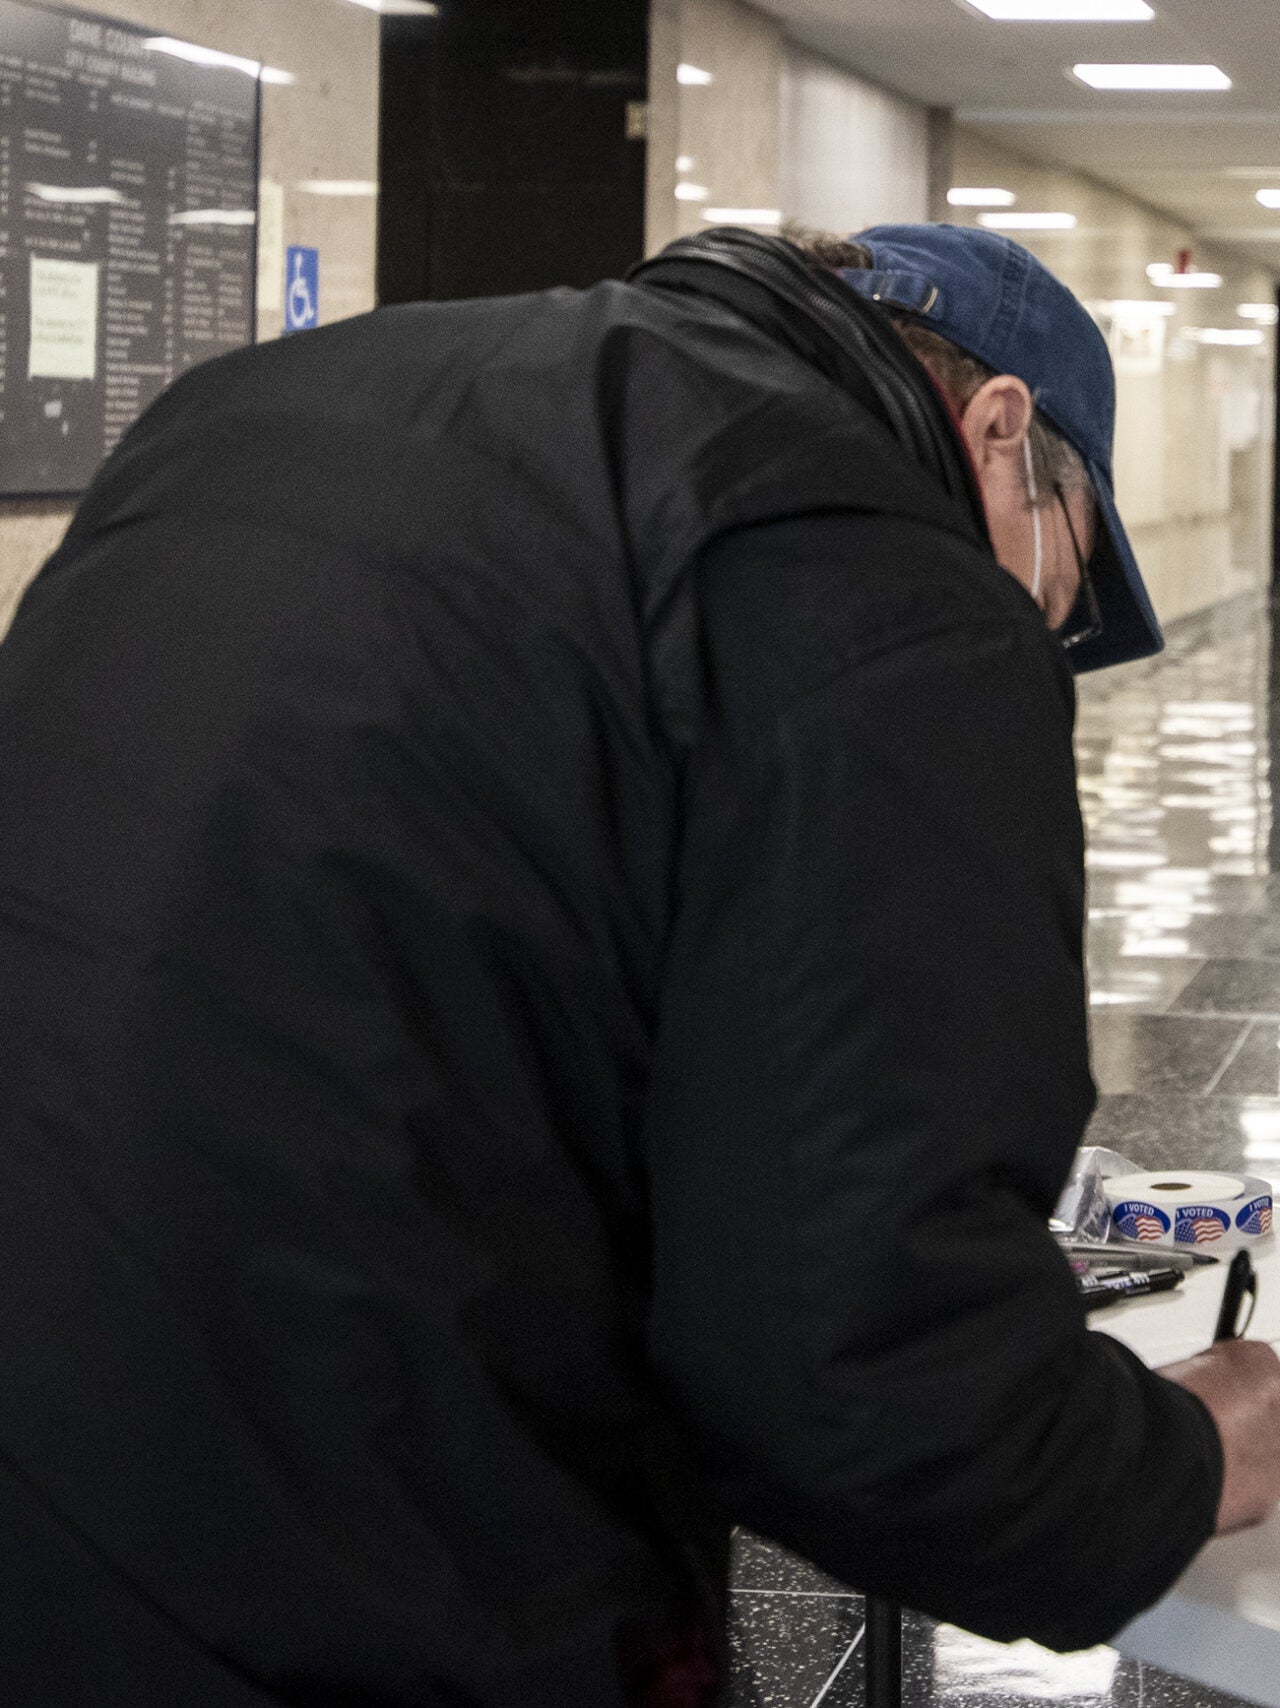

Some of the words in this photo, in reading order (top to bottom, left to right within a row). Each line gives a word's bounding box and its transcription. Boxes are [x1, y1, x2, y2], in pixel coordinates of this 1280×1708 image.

[1124, 1203, 1129, 1212] I
[1128, 1203, 1155, 1217] VOTED
[1176, 1210, 1180, 1219] I
[1182, 1207, 1214, 1218] VOTED
